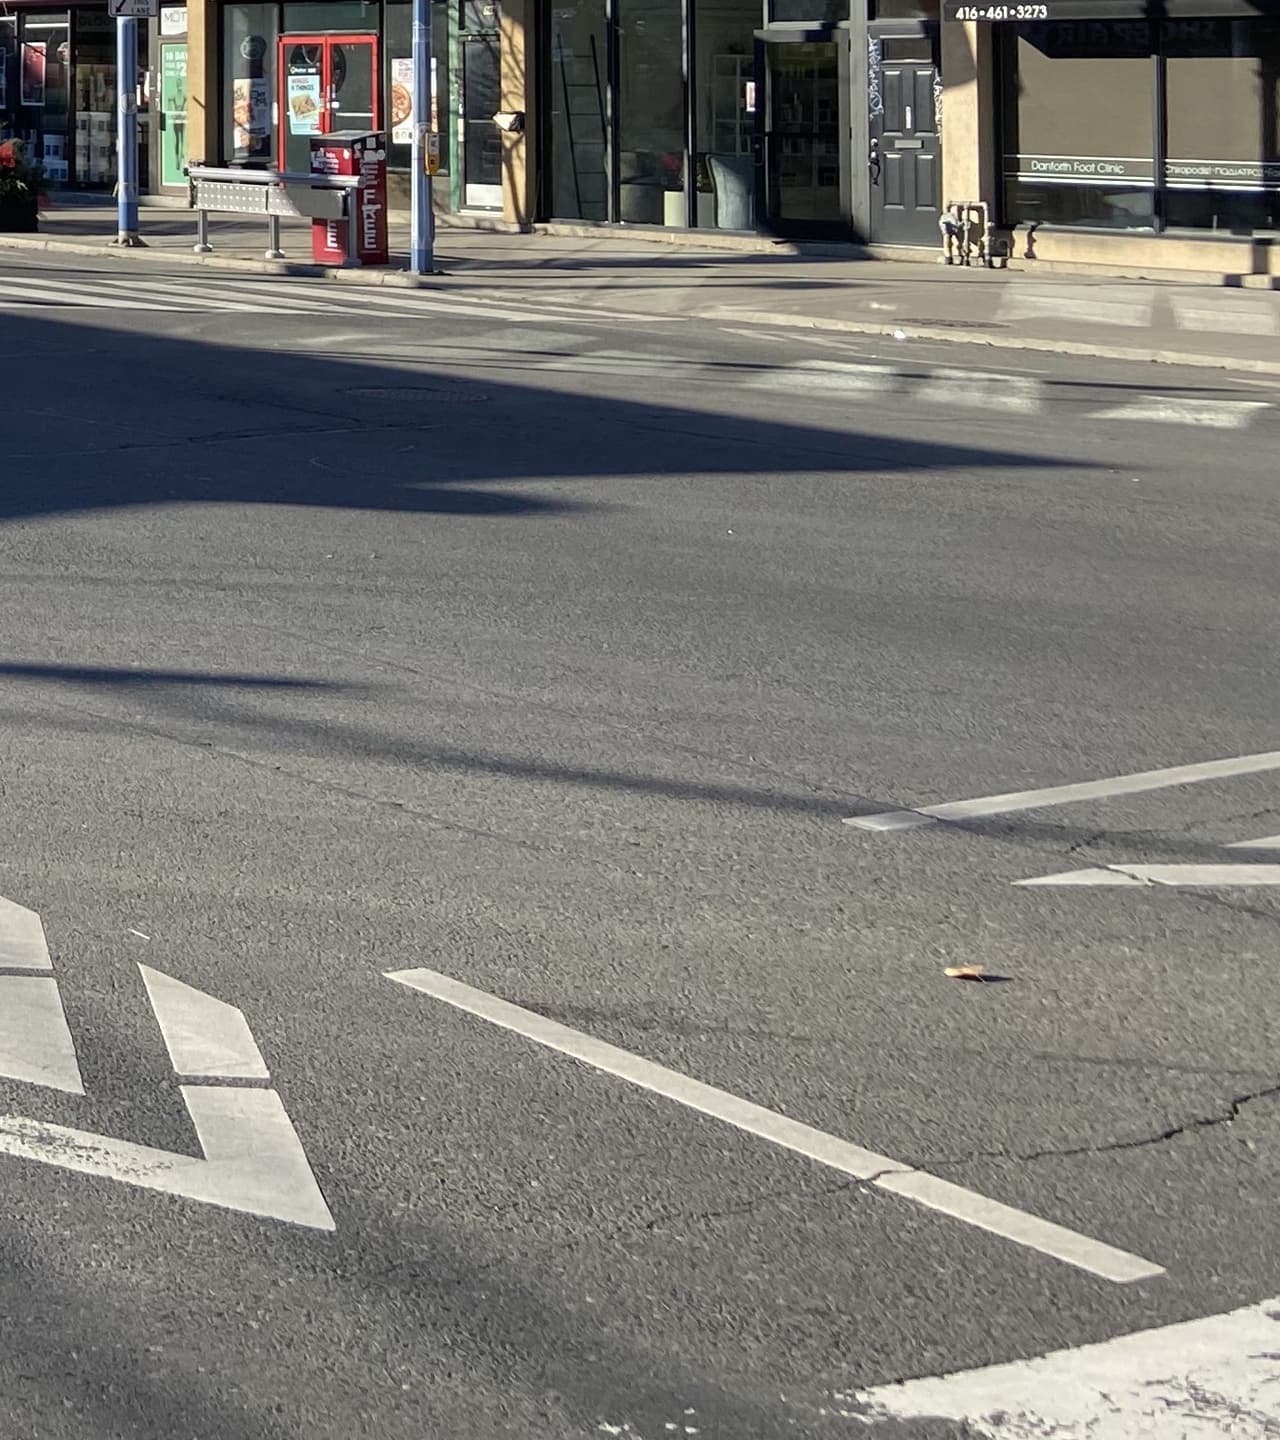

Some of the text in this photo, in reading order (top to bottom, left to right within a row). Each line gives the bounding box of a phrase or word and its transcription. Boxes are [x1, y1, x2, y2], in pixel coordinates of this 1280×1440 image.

[1031, 160, 1125, 174] Danforth Foot Clinic
